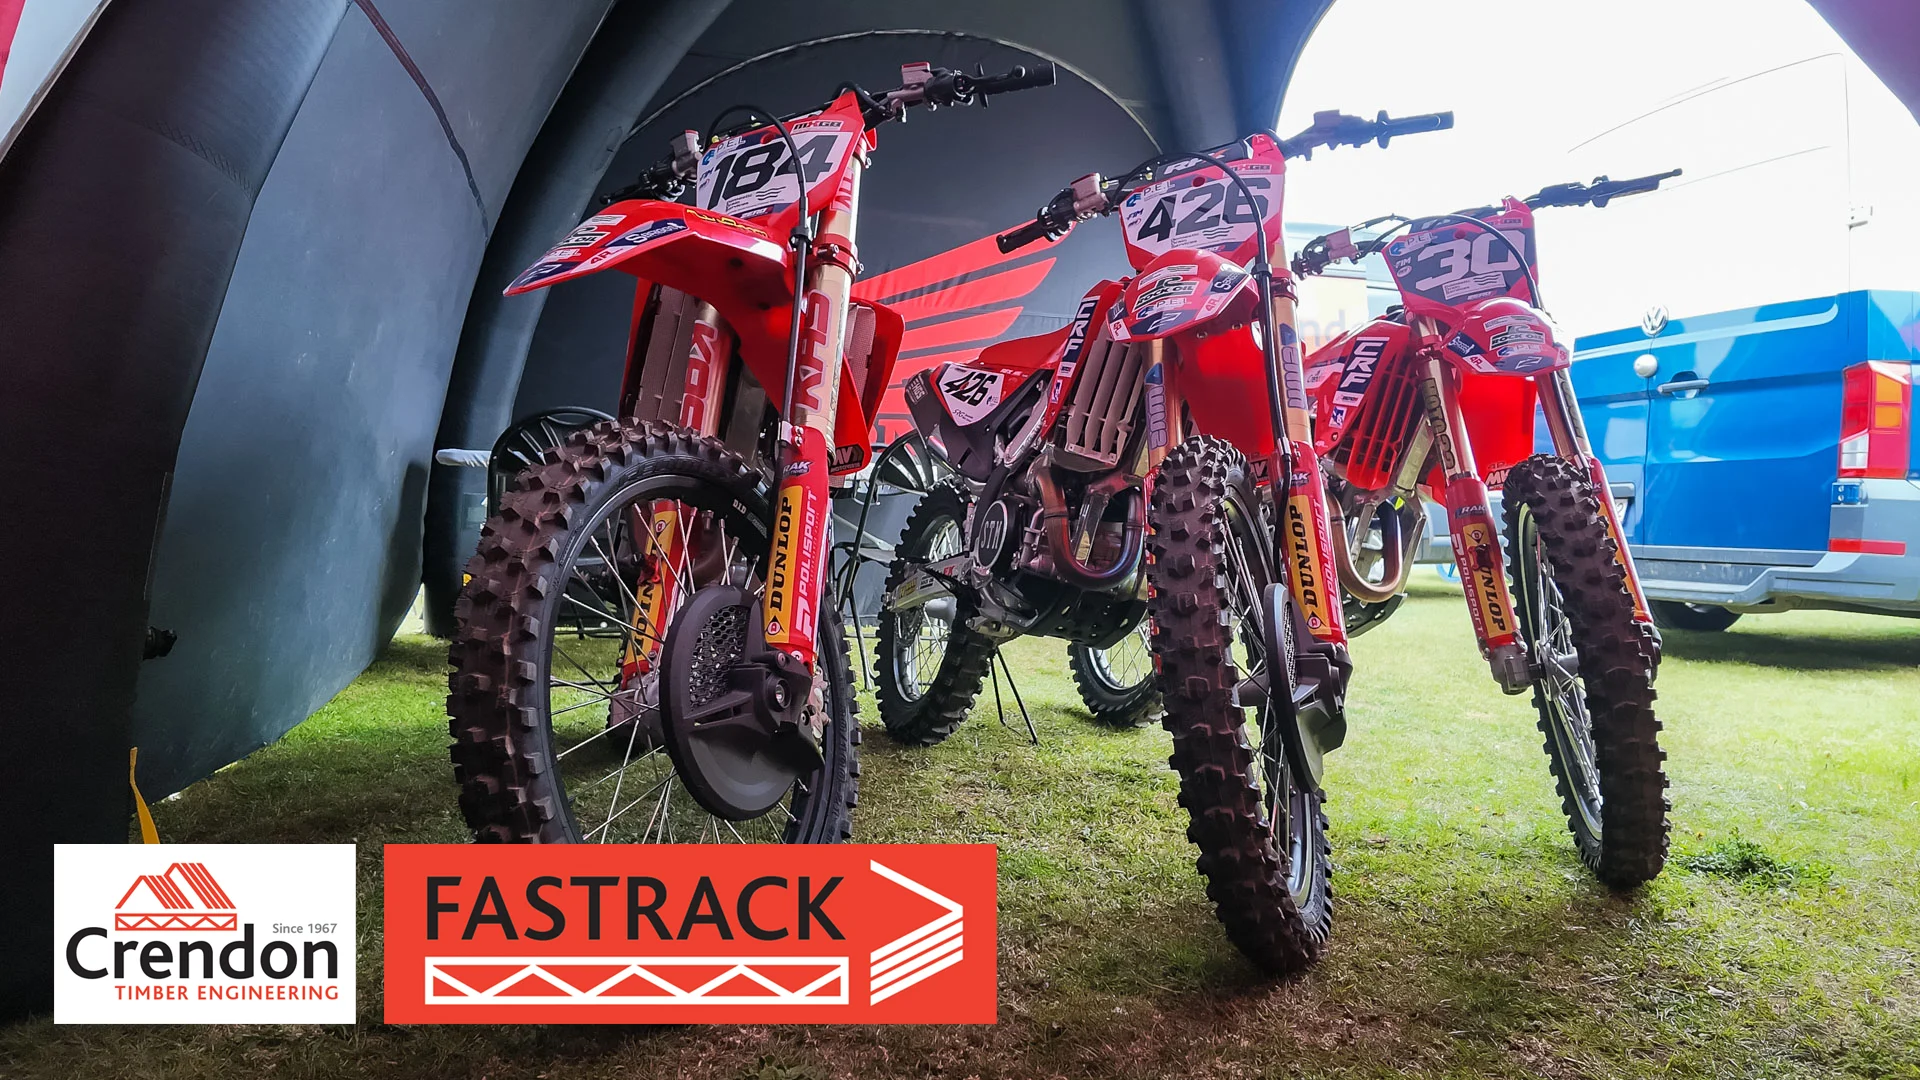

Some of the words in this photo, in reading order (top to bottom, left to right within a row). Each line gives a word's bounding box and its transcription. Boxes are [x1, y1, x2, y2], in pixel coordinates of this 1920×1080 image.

[707, 134, 838, 211] 184
[1136, 177, 1272, 243] 426
[1415, 230, 1526, 291] 30
[1137, 287, 1172, 305] ROCK
[1063, 301, 1096, 358] CRF
[1490, 334, 1522, 344] ROCK
[943, 371, 999, 407] 426
[1339, 341, 1384, 389] CRF
[769, 496, 794, 612] DUNLOP
[798, 489, 818, 595] POLISPORT
[1288, 504, 1320, 609] DUNLOP
[1313, 498, 1337, 594] POLISPORT
[1460, 557, 1484, 633] POLISPORT
